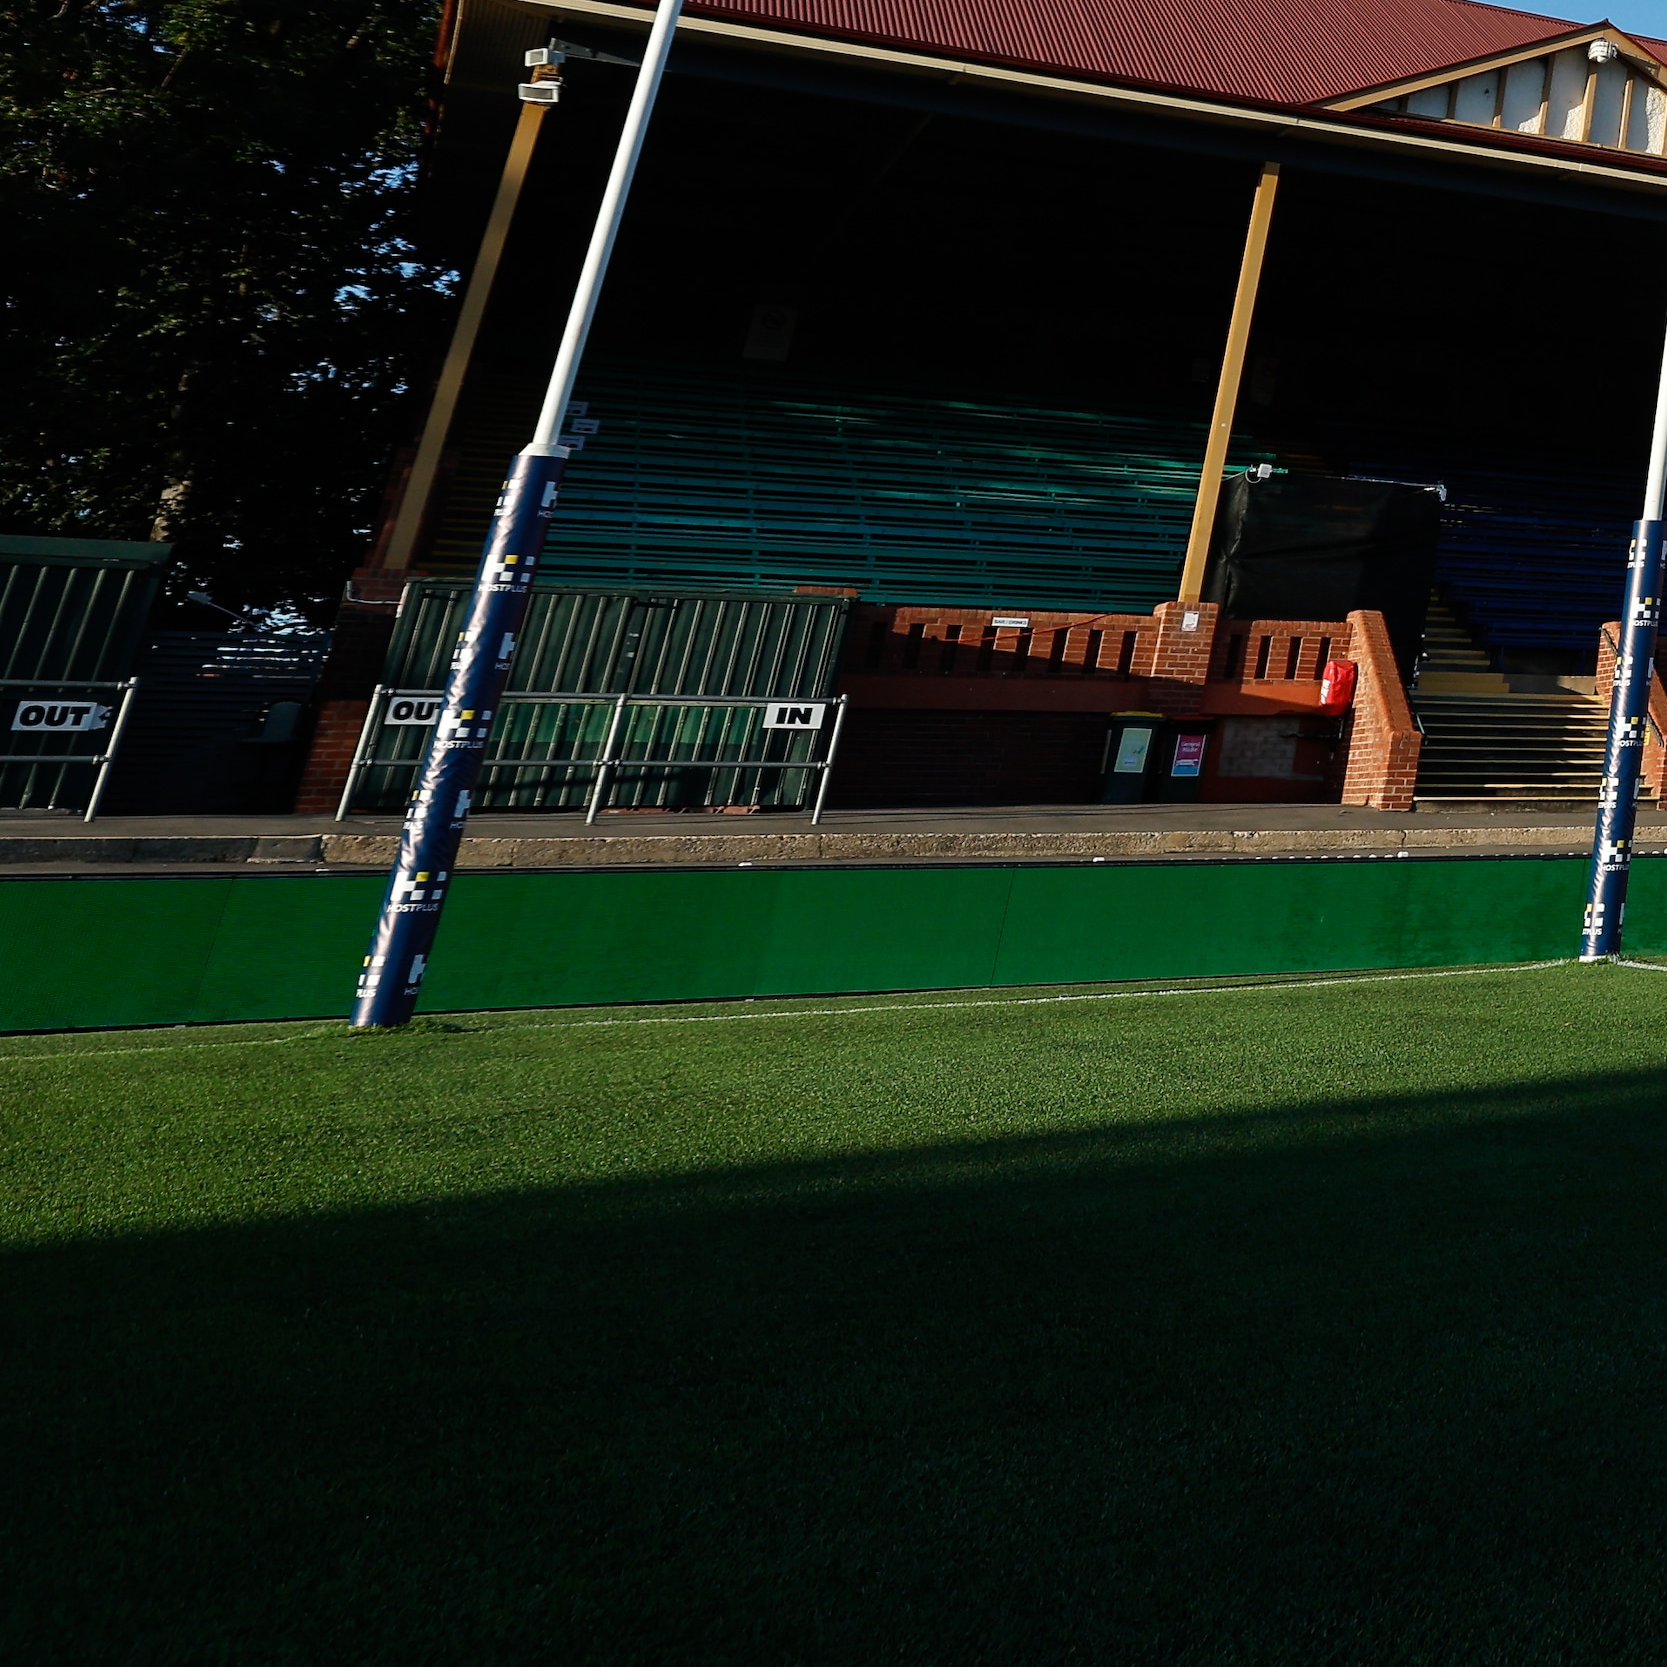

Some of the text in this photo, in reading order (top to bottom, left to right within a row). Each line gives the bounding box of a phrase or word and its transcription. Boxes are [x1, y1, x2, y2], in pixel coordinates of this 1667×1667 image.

[19, 705, 92, 727] OUT
[392, 701, 438, 721] OU
[775, 707, 814, 725] IN
[386, 903, 439, 913] HOSTPLUS
